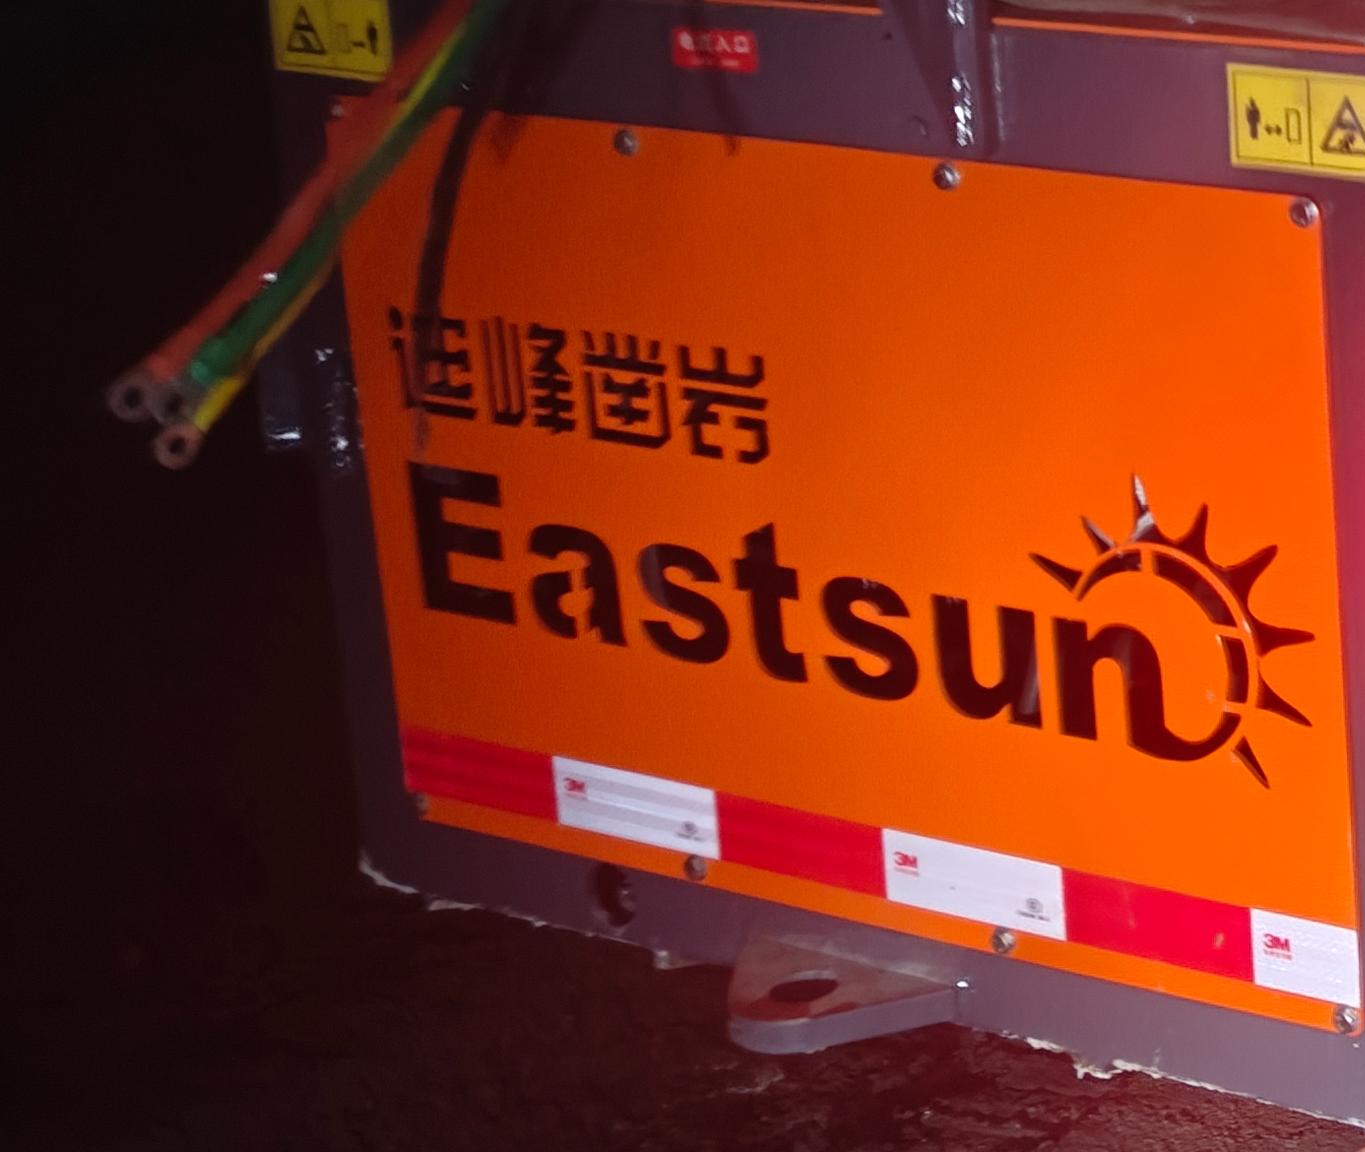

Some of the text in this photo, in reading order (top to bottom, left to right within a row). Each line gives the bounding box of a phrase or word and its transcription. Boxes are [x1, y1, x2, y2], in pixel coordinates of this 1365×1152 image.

[407, 460, 1250, 763] Eastsun
[893, 851, 917, 869] 3M
[1263, 933, 1290, 952] 3M
